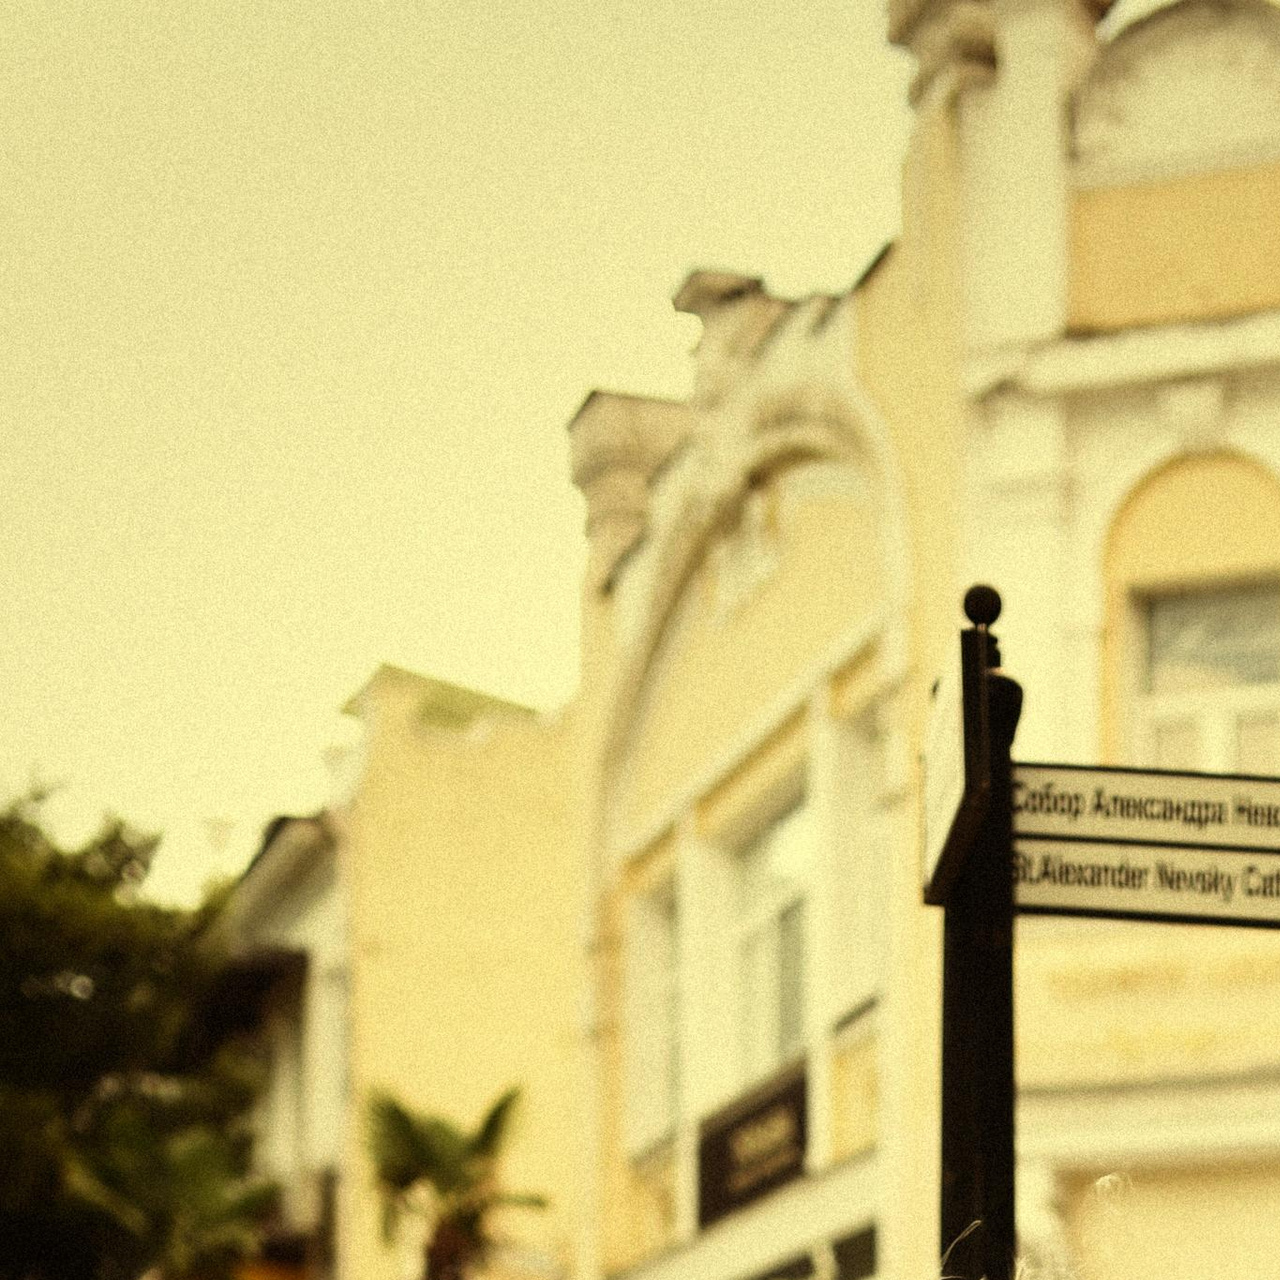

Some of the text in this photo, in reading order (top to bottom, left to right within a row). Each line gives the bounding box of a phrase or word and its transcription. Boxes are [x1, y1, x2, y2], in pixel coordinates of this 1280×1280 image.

[1012, 781, 1083, 822] Собор
[1091, 786, 1222, 831] Александра
[1155, 860, 1237, 904] Nevsky
